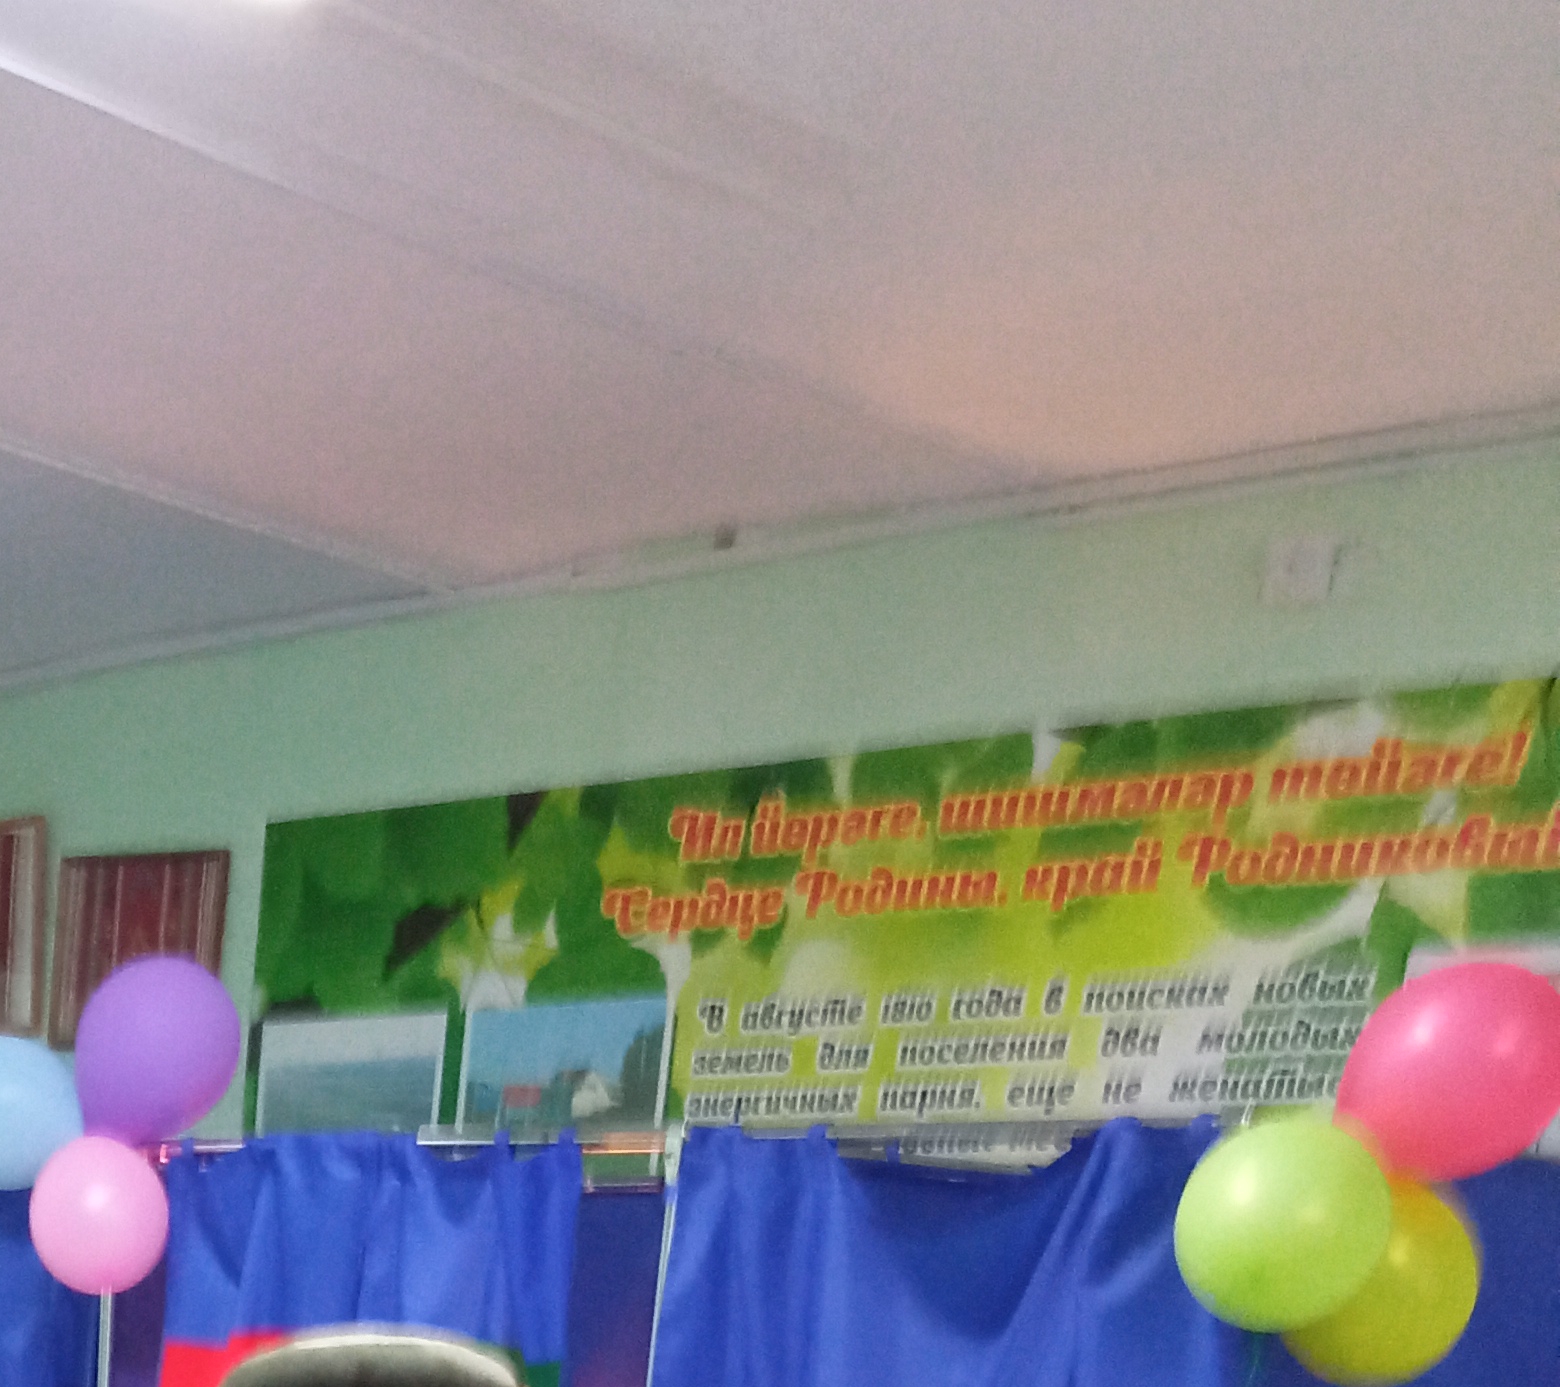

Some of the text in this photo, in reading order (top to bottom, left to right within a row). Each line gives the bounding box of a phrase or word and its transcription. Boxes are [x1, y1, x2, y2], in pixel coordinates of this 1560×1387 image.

[602, 877, 783, 942] Сердце
[1023, 836, 1162, 911] край
[743, 998, 866, 1036] августе
[952, 988, 1024, 1021] года
[1044, 984, 1064, 1016] в
[1083, 985, 1229, 1014] поисках
[1253, 972, 1370, 1005] новых
[693, 1052, 792, 1076] земель
[819, 1042, 872, 1070] для
[897, 1040, 1069, 1067] поселения
[1100, 1025, 1161, 1057] два
[1006, 1084, 1076, 1116] еще
[1101, 1080, 1143, 1105] не
